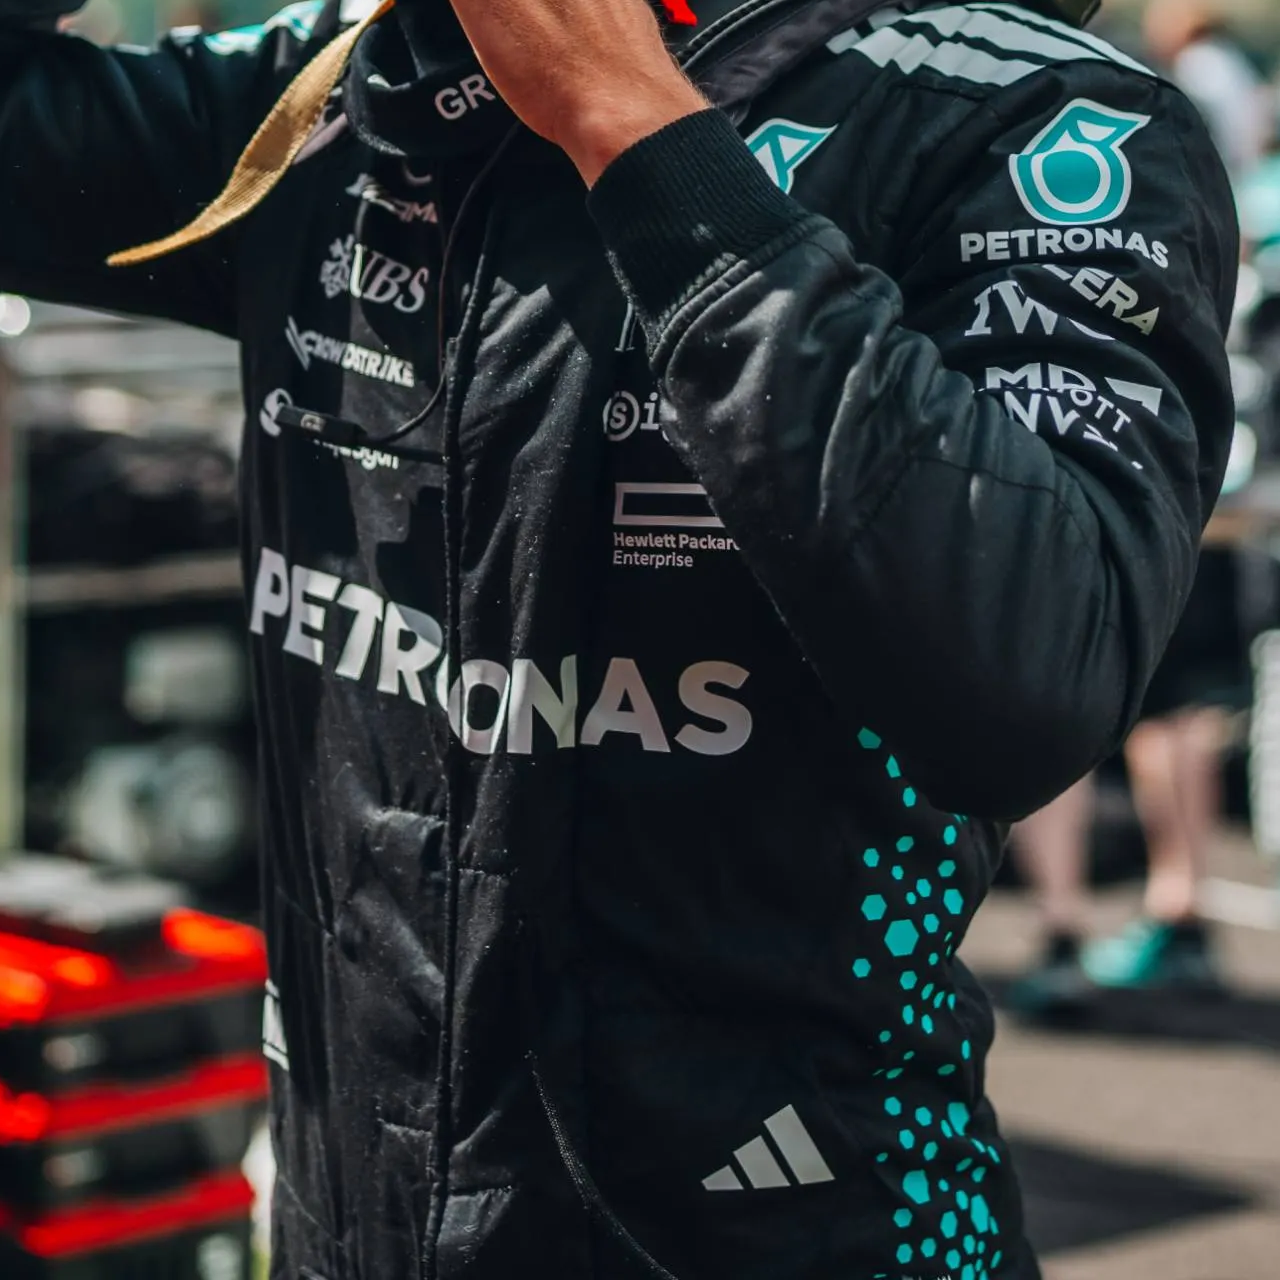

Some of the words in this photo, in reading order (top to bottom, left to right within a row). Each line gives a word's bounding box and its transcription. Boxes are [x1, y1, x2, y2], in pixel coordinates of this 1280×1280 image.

[960, 227, 1169, 268] PETRONAS
[613, 532, 677, 550] Hewlett
[613, 550, 694, 569] Enterprise
[249, 546, 754, 757] PETRONAS
